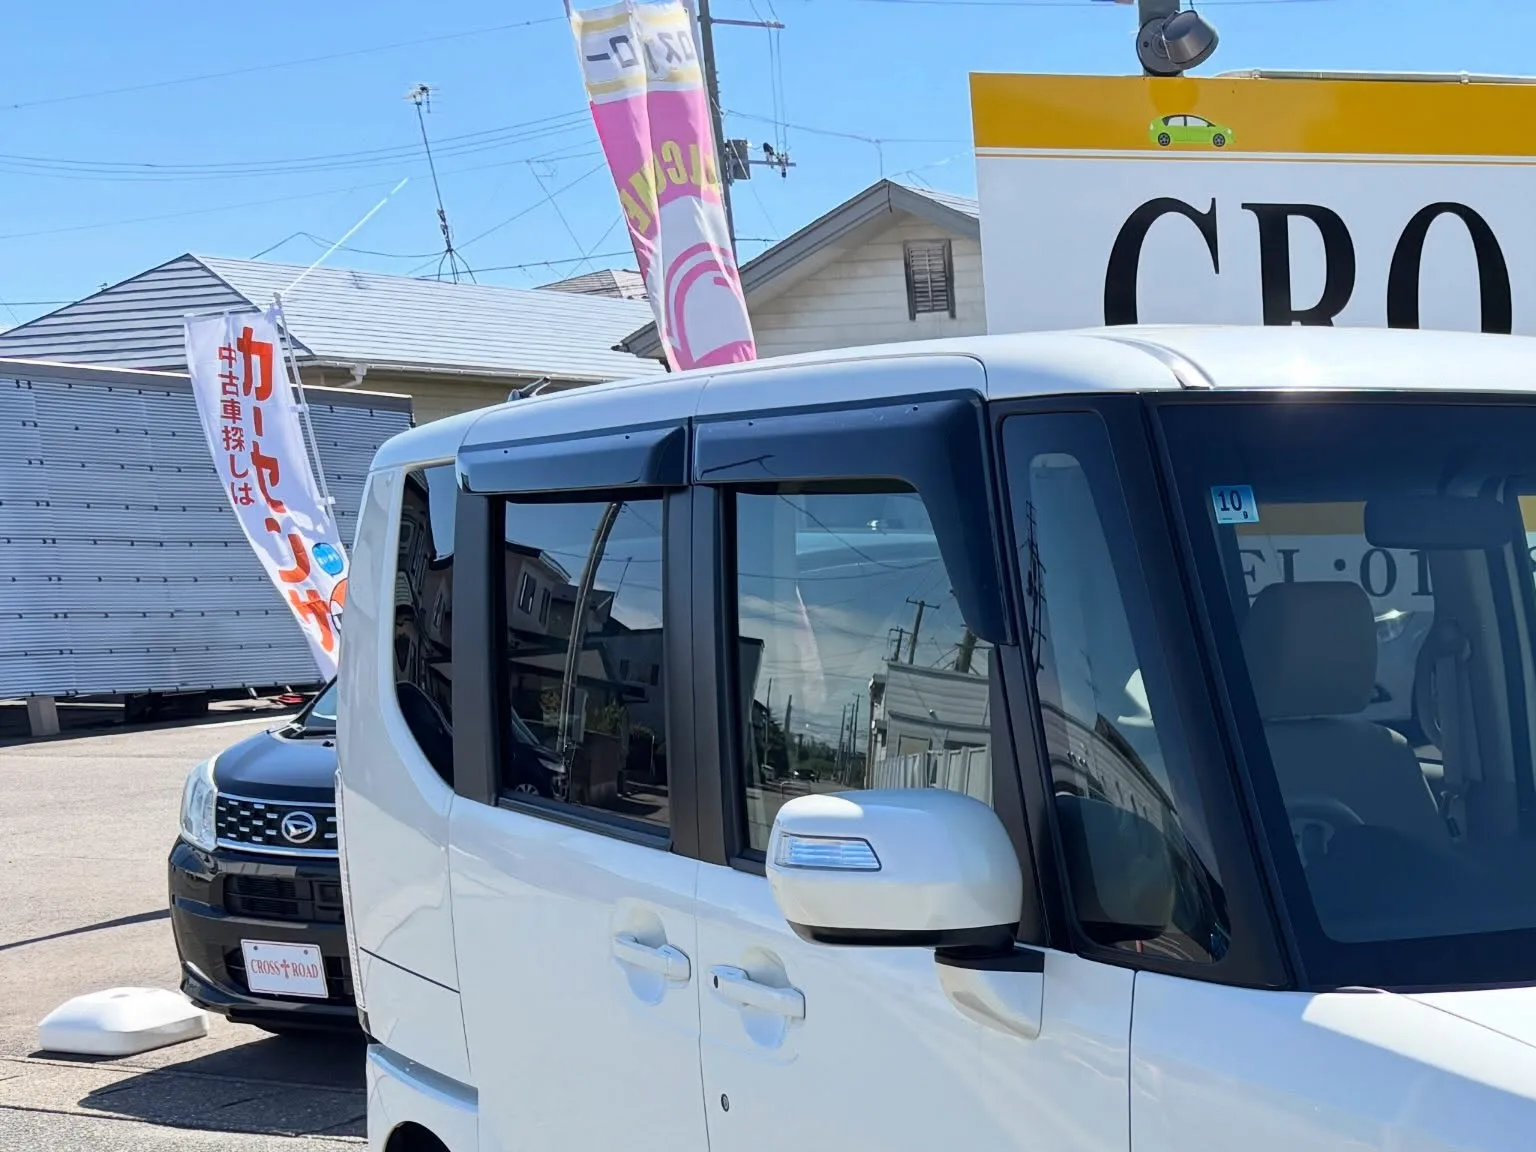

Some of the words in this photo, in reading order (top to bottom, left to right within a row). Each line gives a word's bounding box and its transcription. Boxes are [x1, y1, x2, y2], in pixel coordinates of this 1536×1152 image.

[218, 343, 255, 505] 中古車探しは
[1218, 491, 1242, 511] 10
[251, 959, 281, 976] CROSS
[291, 962, 319, 978] ROAD
